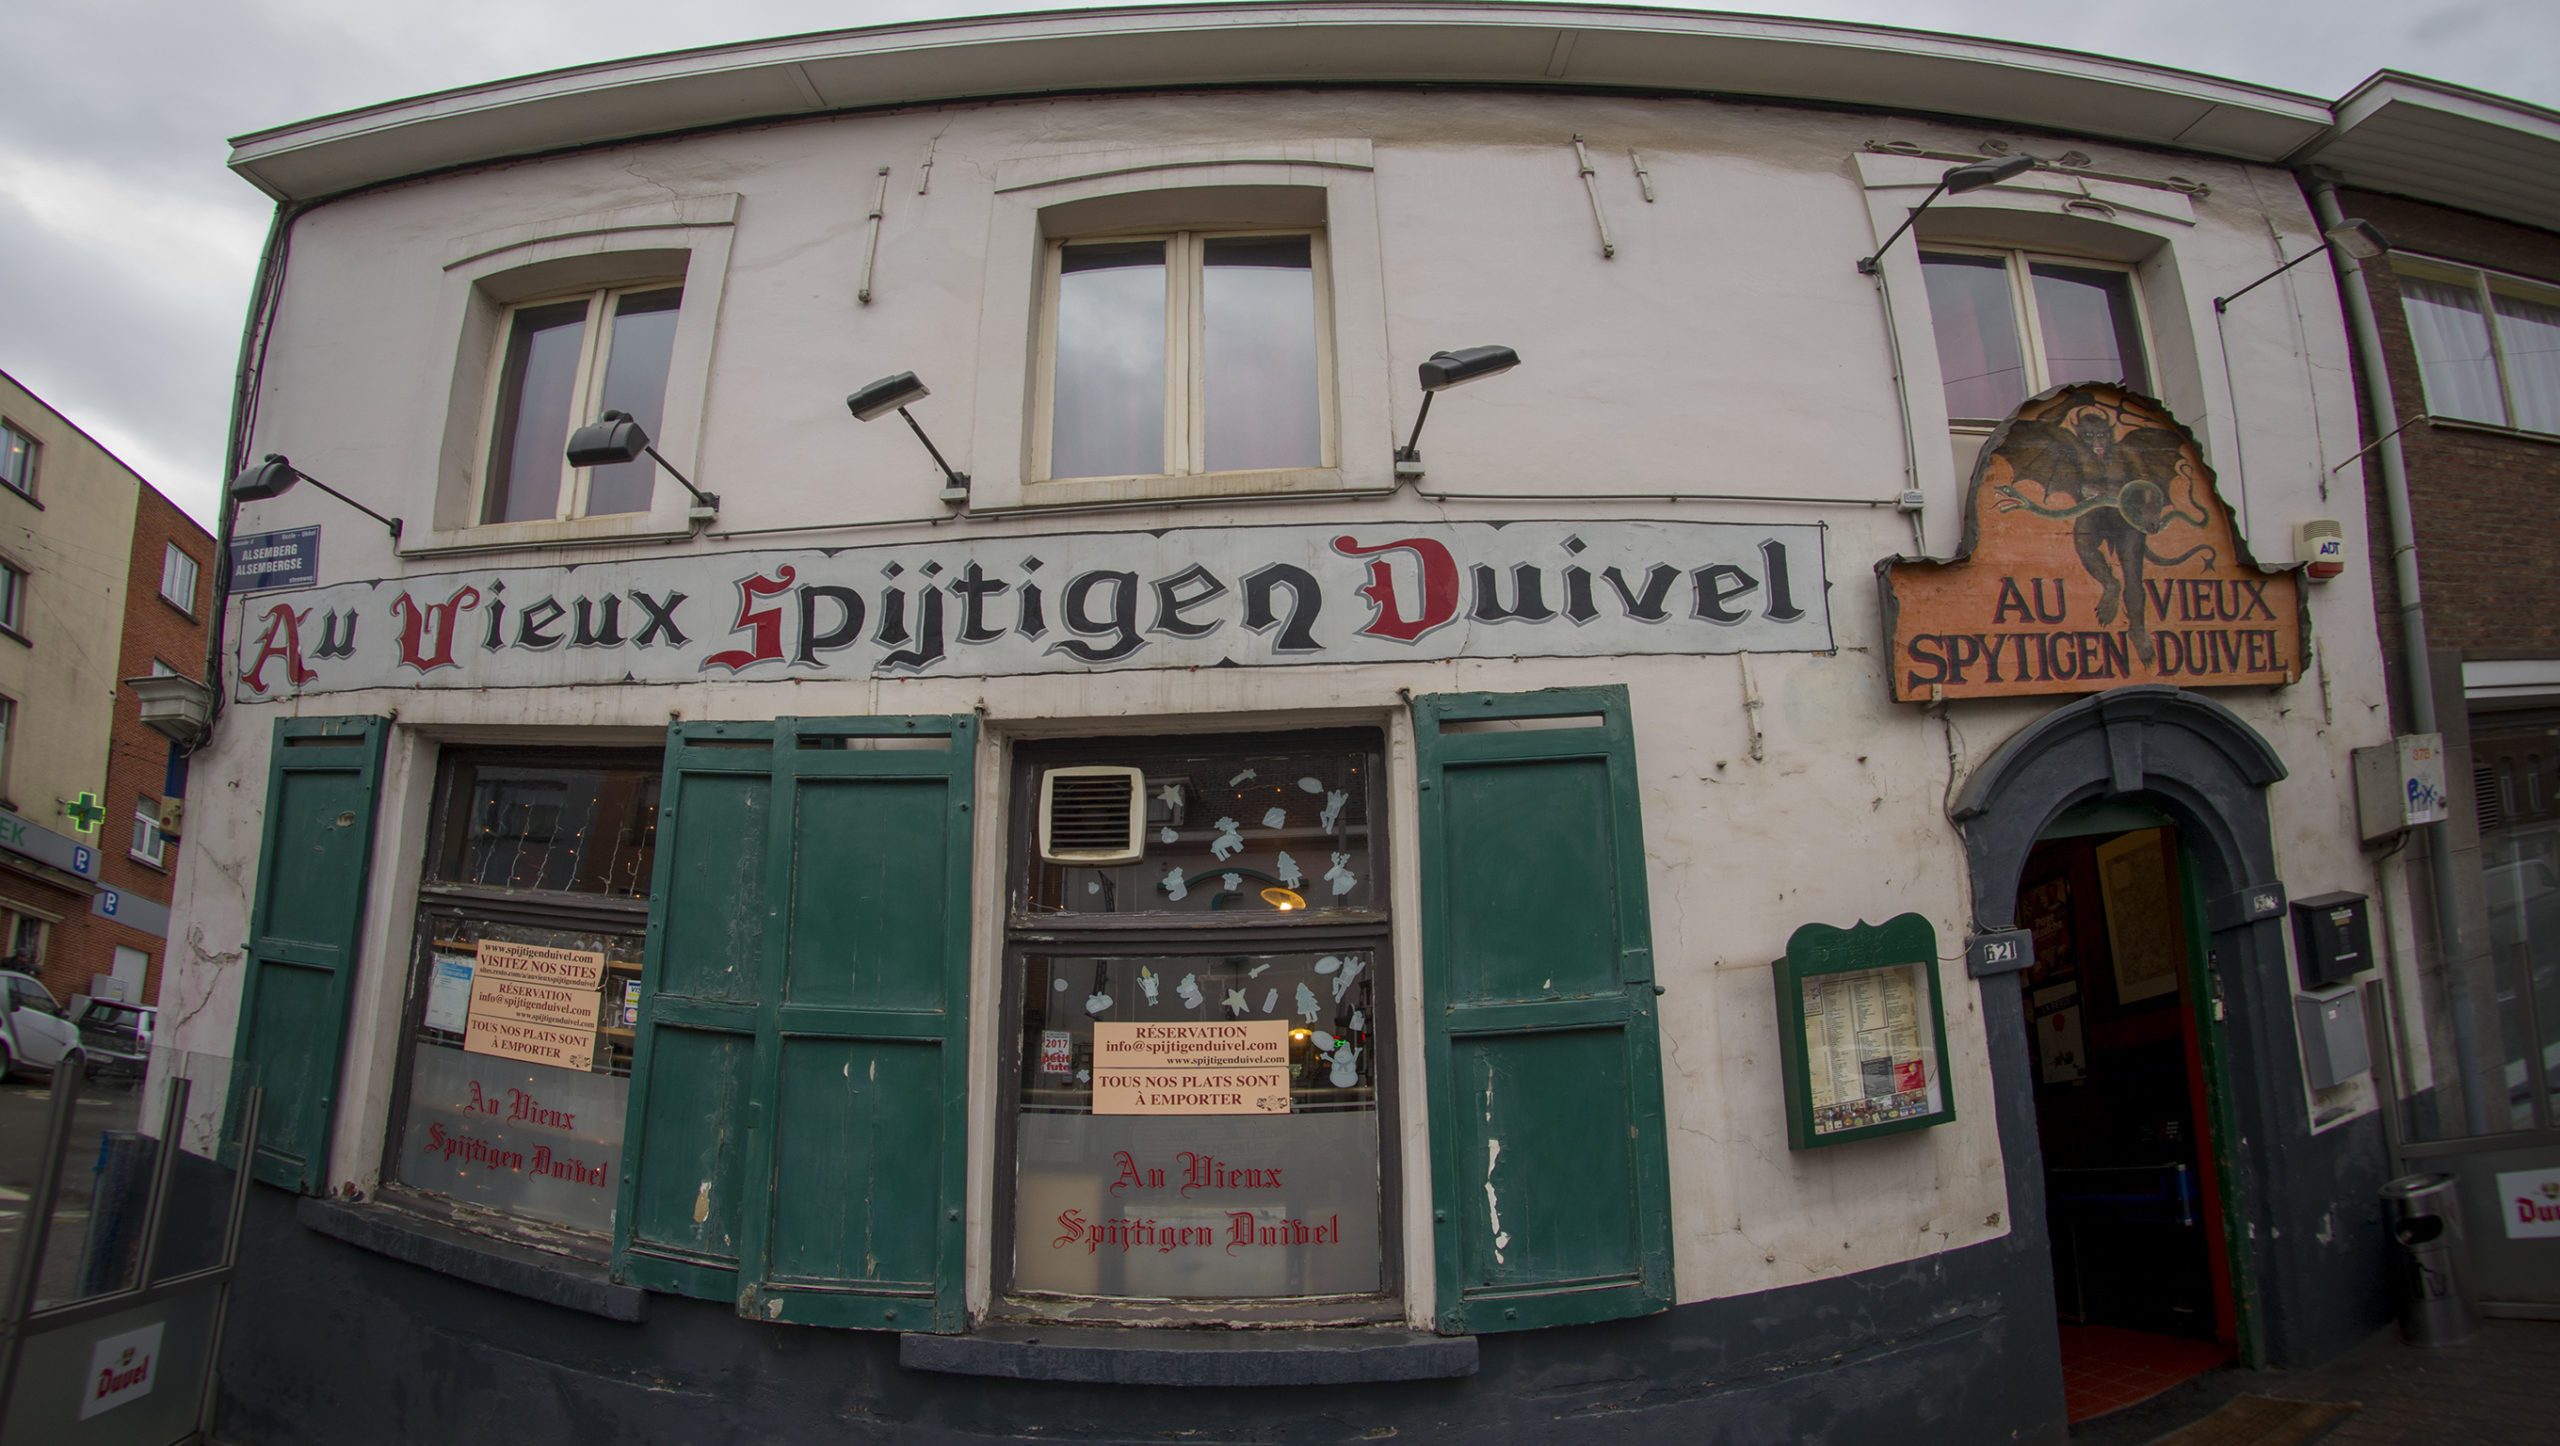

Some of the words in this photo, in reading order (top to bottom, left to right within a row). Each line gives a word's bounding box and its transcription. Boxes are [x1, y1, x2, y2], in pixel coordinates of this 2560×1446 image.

[241, 544, 298, 561] ALSEMBERG
[2320, 541, 2341, 555] ADT
[235, 558, 303, 576] ALSEMBERGSE
[1992, 577, 2067, 625] AU
[2144, 578, 2278, 623] VIEUX
[239, 602, 360, 694] Au
[390, 577, 694, 675] Vieux
[699, 555, 1326, 675] Spijtigen
[1329, 533, 1806, 646] Duivel
[1907, 630, 2131, 693] SPYTIGEN
[2151, 629, 2290, 677] DUIVEL
[484, 943, 594, 964] www.spijtigenduivel.com
[1984, 940, 2017, 963] 621
[480, 954, 529, 971] VISITEZ
[531, 961, 557, 975] NOS
[559, 964, 597, 979] SITES
[499, 982, 573, 1002] RÉSERVATION
[479, 992, 591, 1016] info@spijtigenduivel.com
[516, 1011, 595, 1028] www.spijtigenduivel.com
[471, 1019, 498, 1033] TOUS
[500, 1024, 521, 1037] NOS
[523, 1028, 557, 1042] PLATS
[558, 1033, 589, 1048] SONT
[1136, 1024, 1248, 1039] RÉSERVATION
[491, 1035, 499, 1049] À
[501, 1040, 561, 1059] EMPORTER
[1045, 1038, 1068, 1049] 2017
[1106, 1040, 1278, 1055] info@spijtigenduivel.com
[1166, 1055, 1286, 1067] www.spijtigenduivel.com
[1099, 1075, 1141, 1088] TOUS
[1145, 1075, 1178, 1088] NOS
[1182, 1075, 1232, 1088] PLATS
[1236, 1074, 1280, 1087] SONT
[1135, 1090, 1146, 1106] À
[1151, 1093, 1242, 1105] EMPORTER
[424, 1122, 523, 1170] Spijtigen
[1052, 1208, 1214, 1255] Spijtigen
[96, 1355, 150, 1399] Duvel
